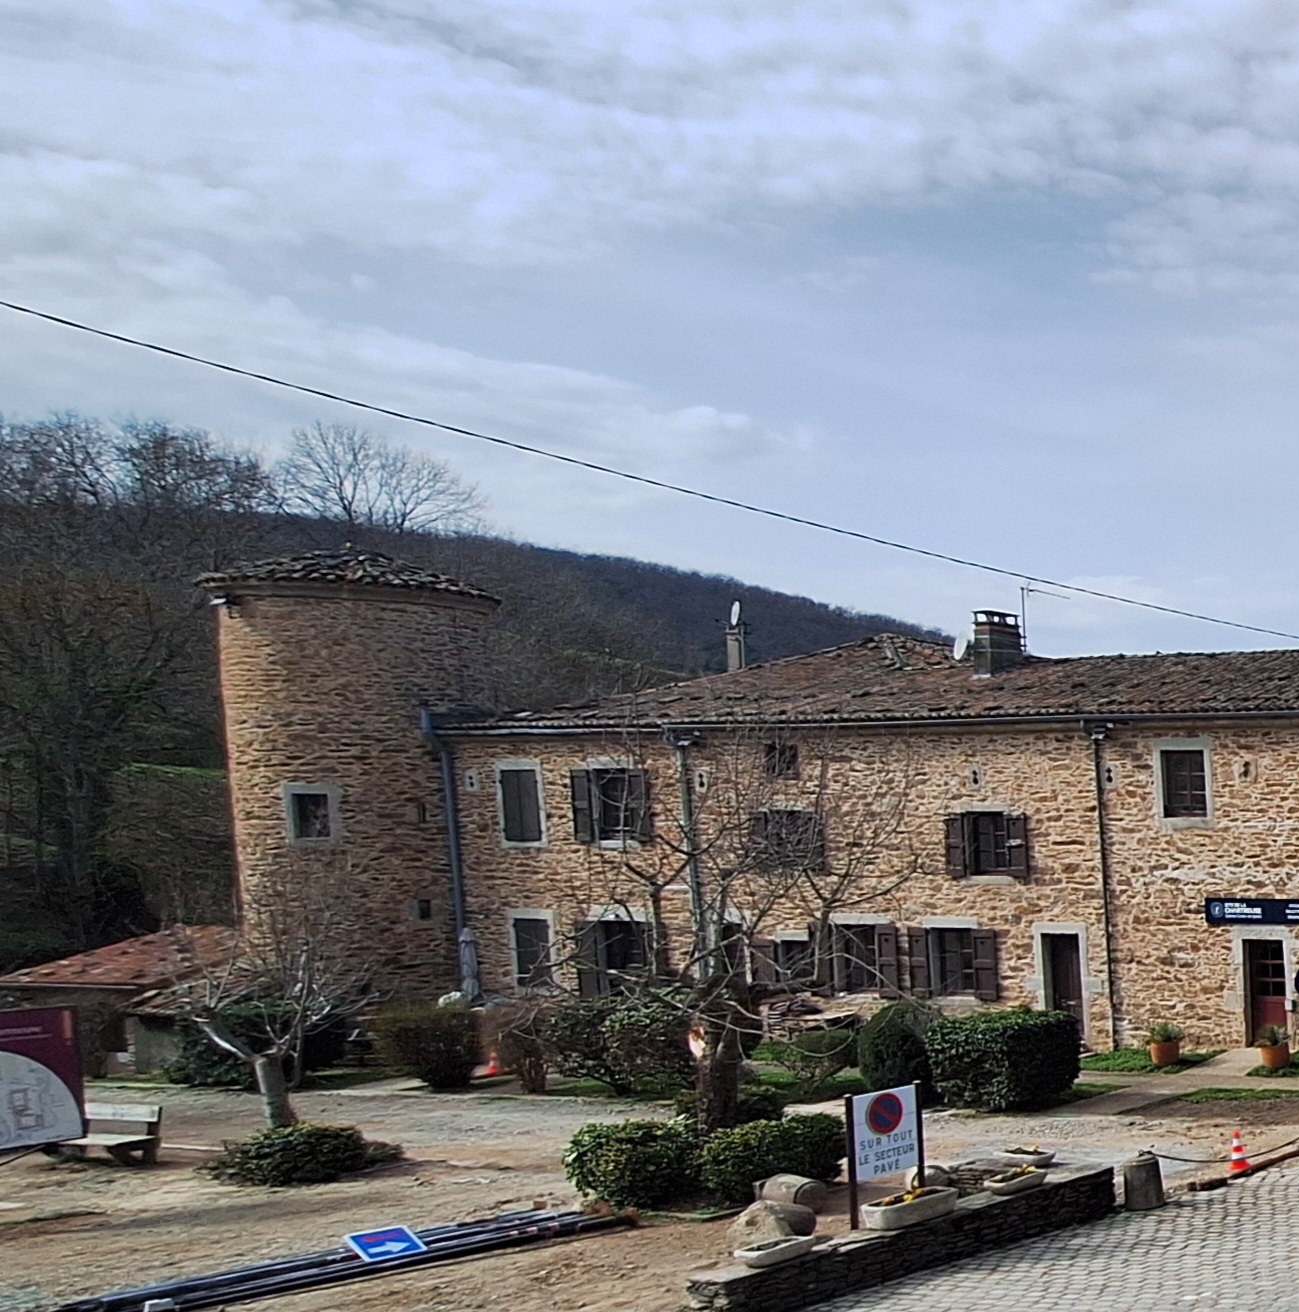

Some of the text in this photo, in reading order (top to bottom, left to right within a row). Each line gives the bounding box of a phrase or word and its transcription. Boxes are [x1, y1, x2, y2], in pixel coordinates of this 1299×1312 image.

[860, 1129, 913, 1151] SUR TOUT
[859, 1143, 915, 1166] LE SECTEUR
[873, 1158, 900, 1175] PAVÉ
